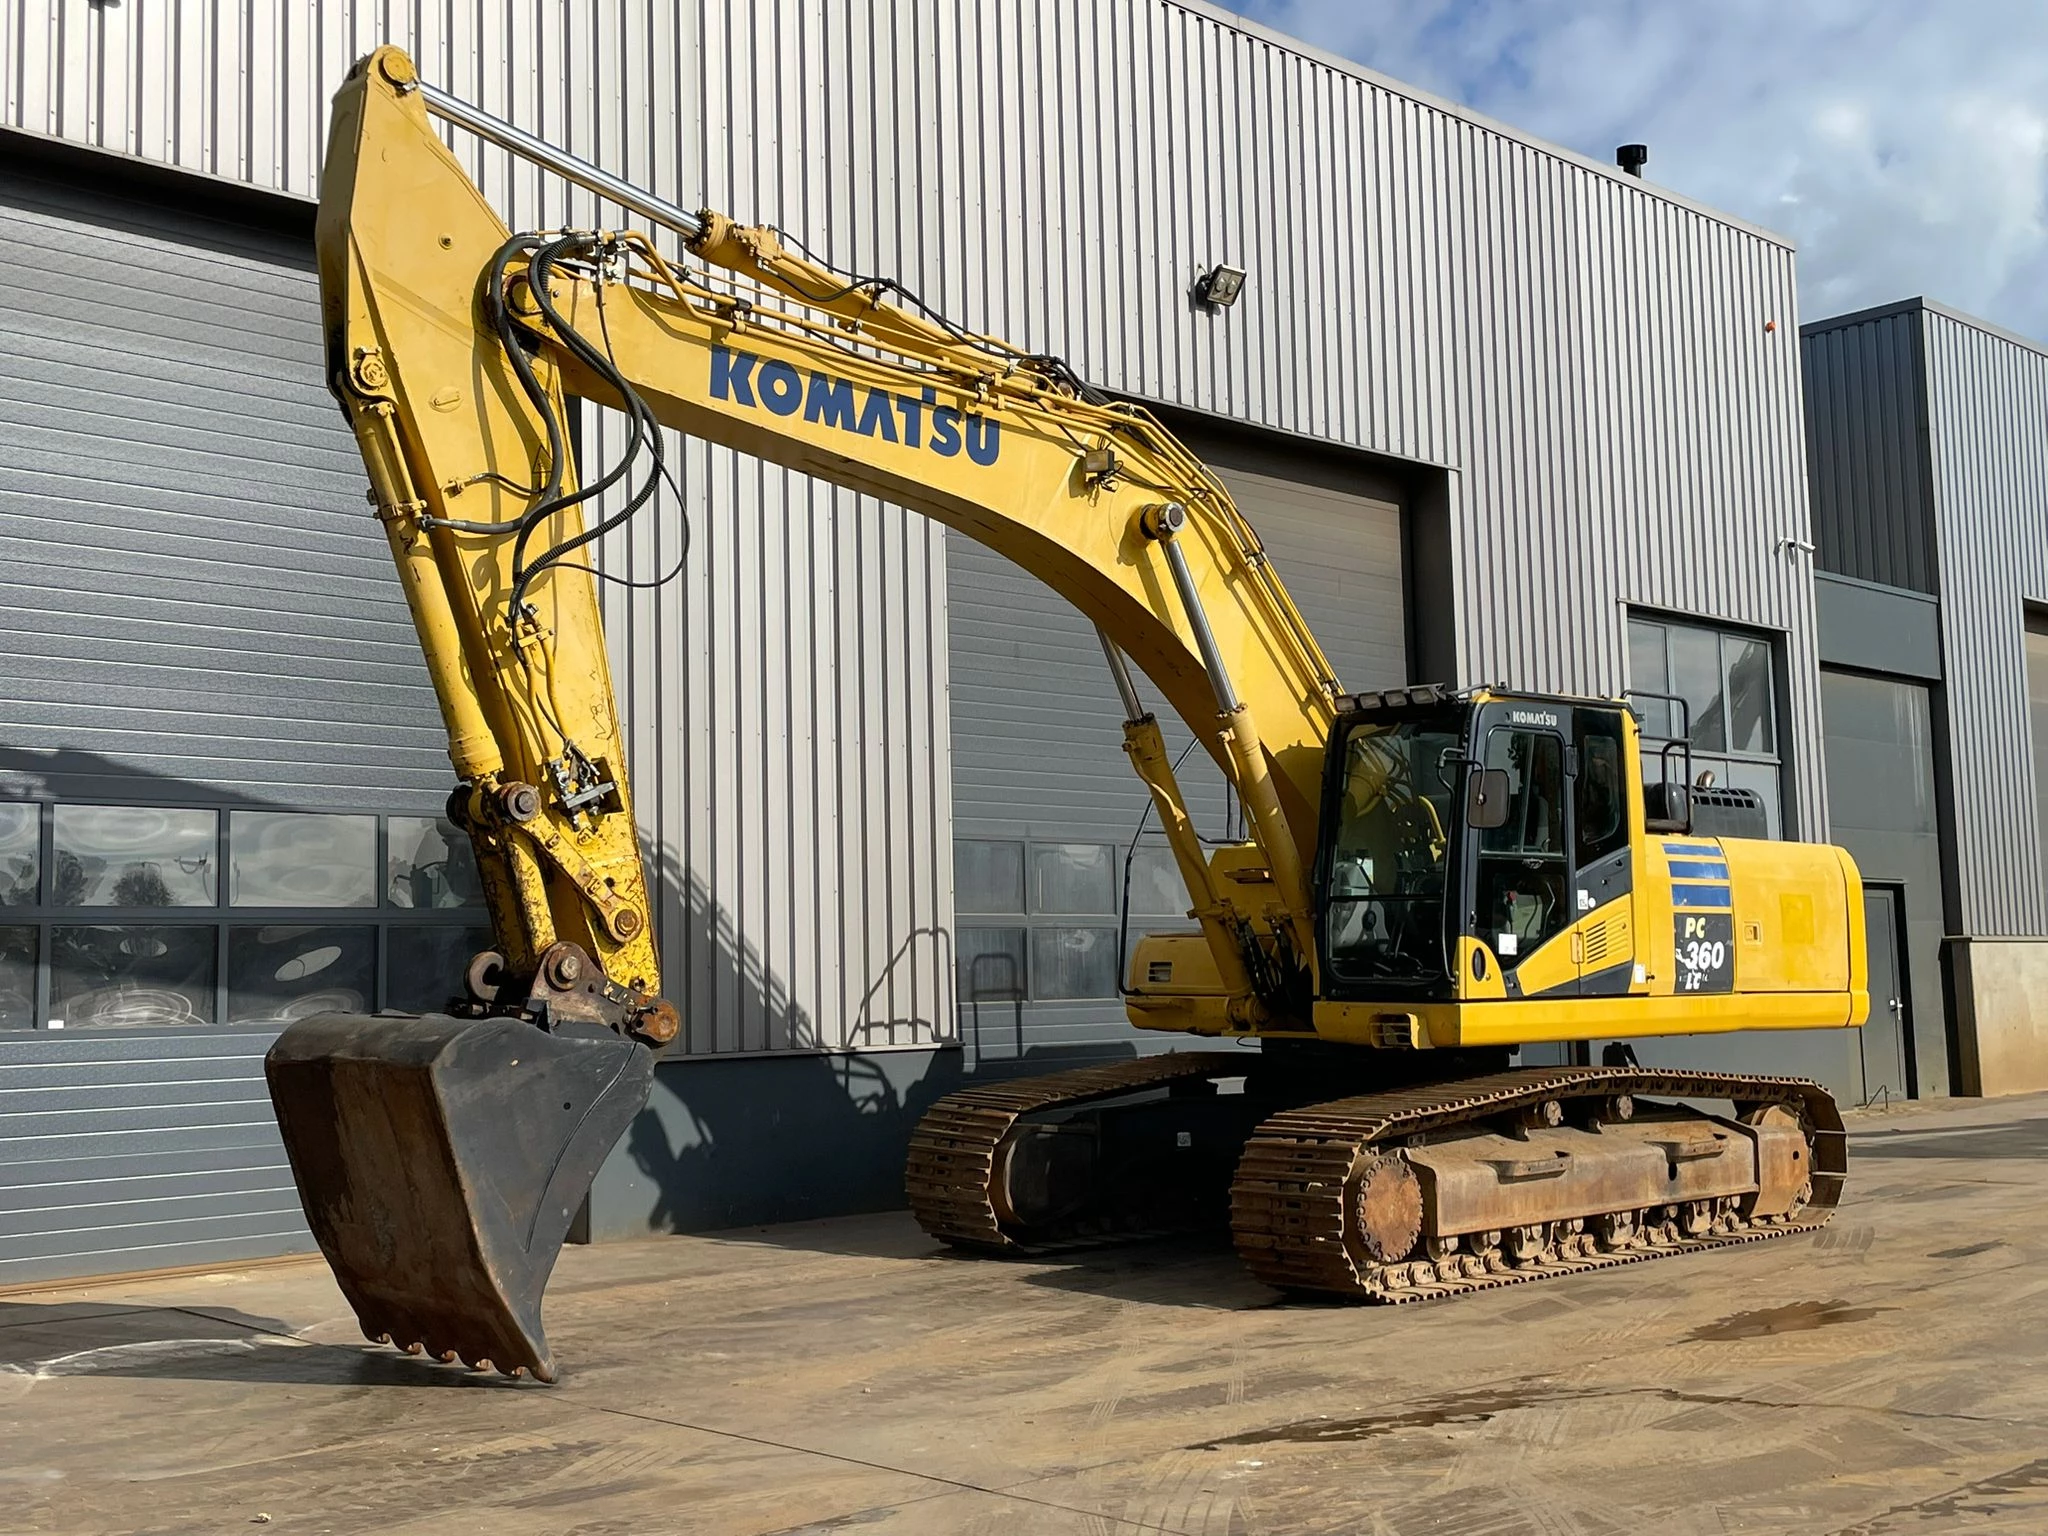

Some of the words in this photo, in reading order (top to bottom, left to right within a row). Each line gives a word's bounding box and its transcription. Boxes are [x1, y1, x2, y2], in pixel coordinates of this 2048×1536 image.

[709, 343, 1000, 466] KOMATSU
[1512, 710, 1558, 726] KOMATSU
[1684, 917, 1706, 939] PC
[1684, 941, 1725, 970] 360
